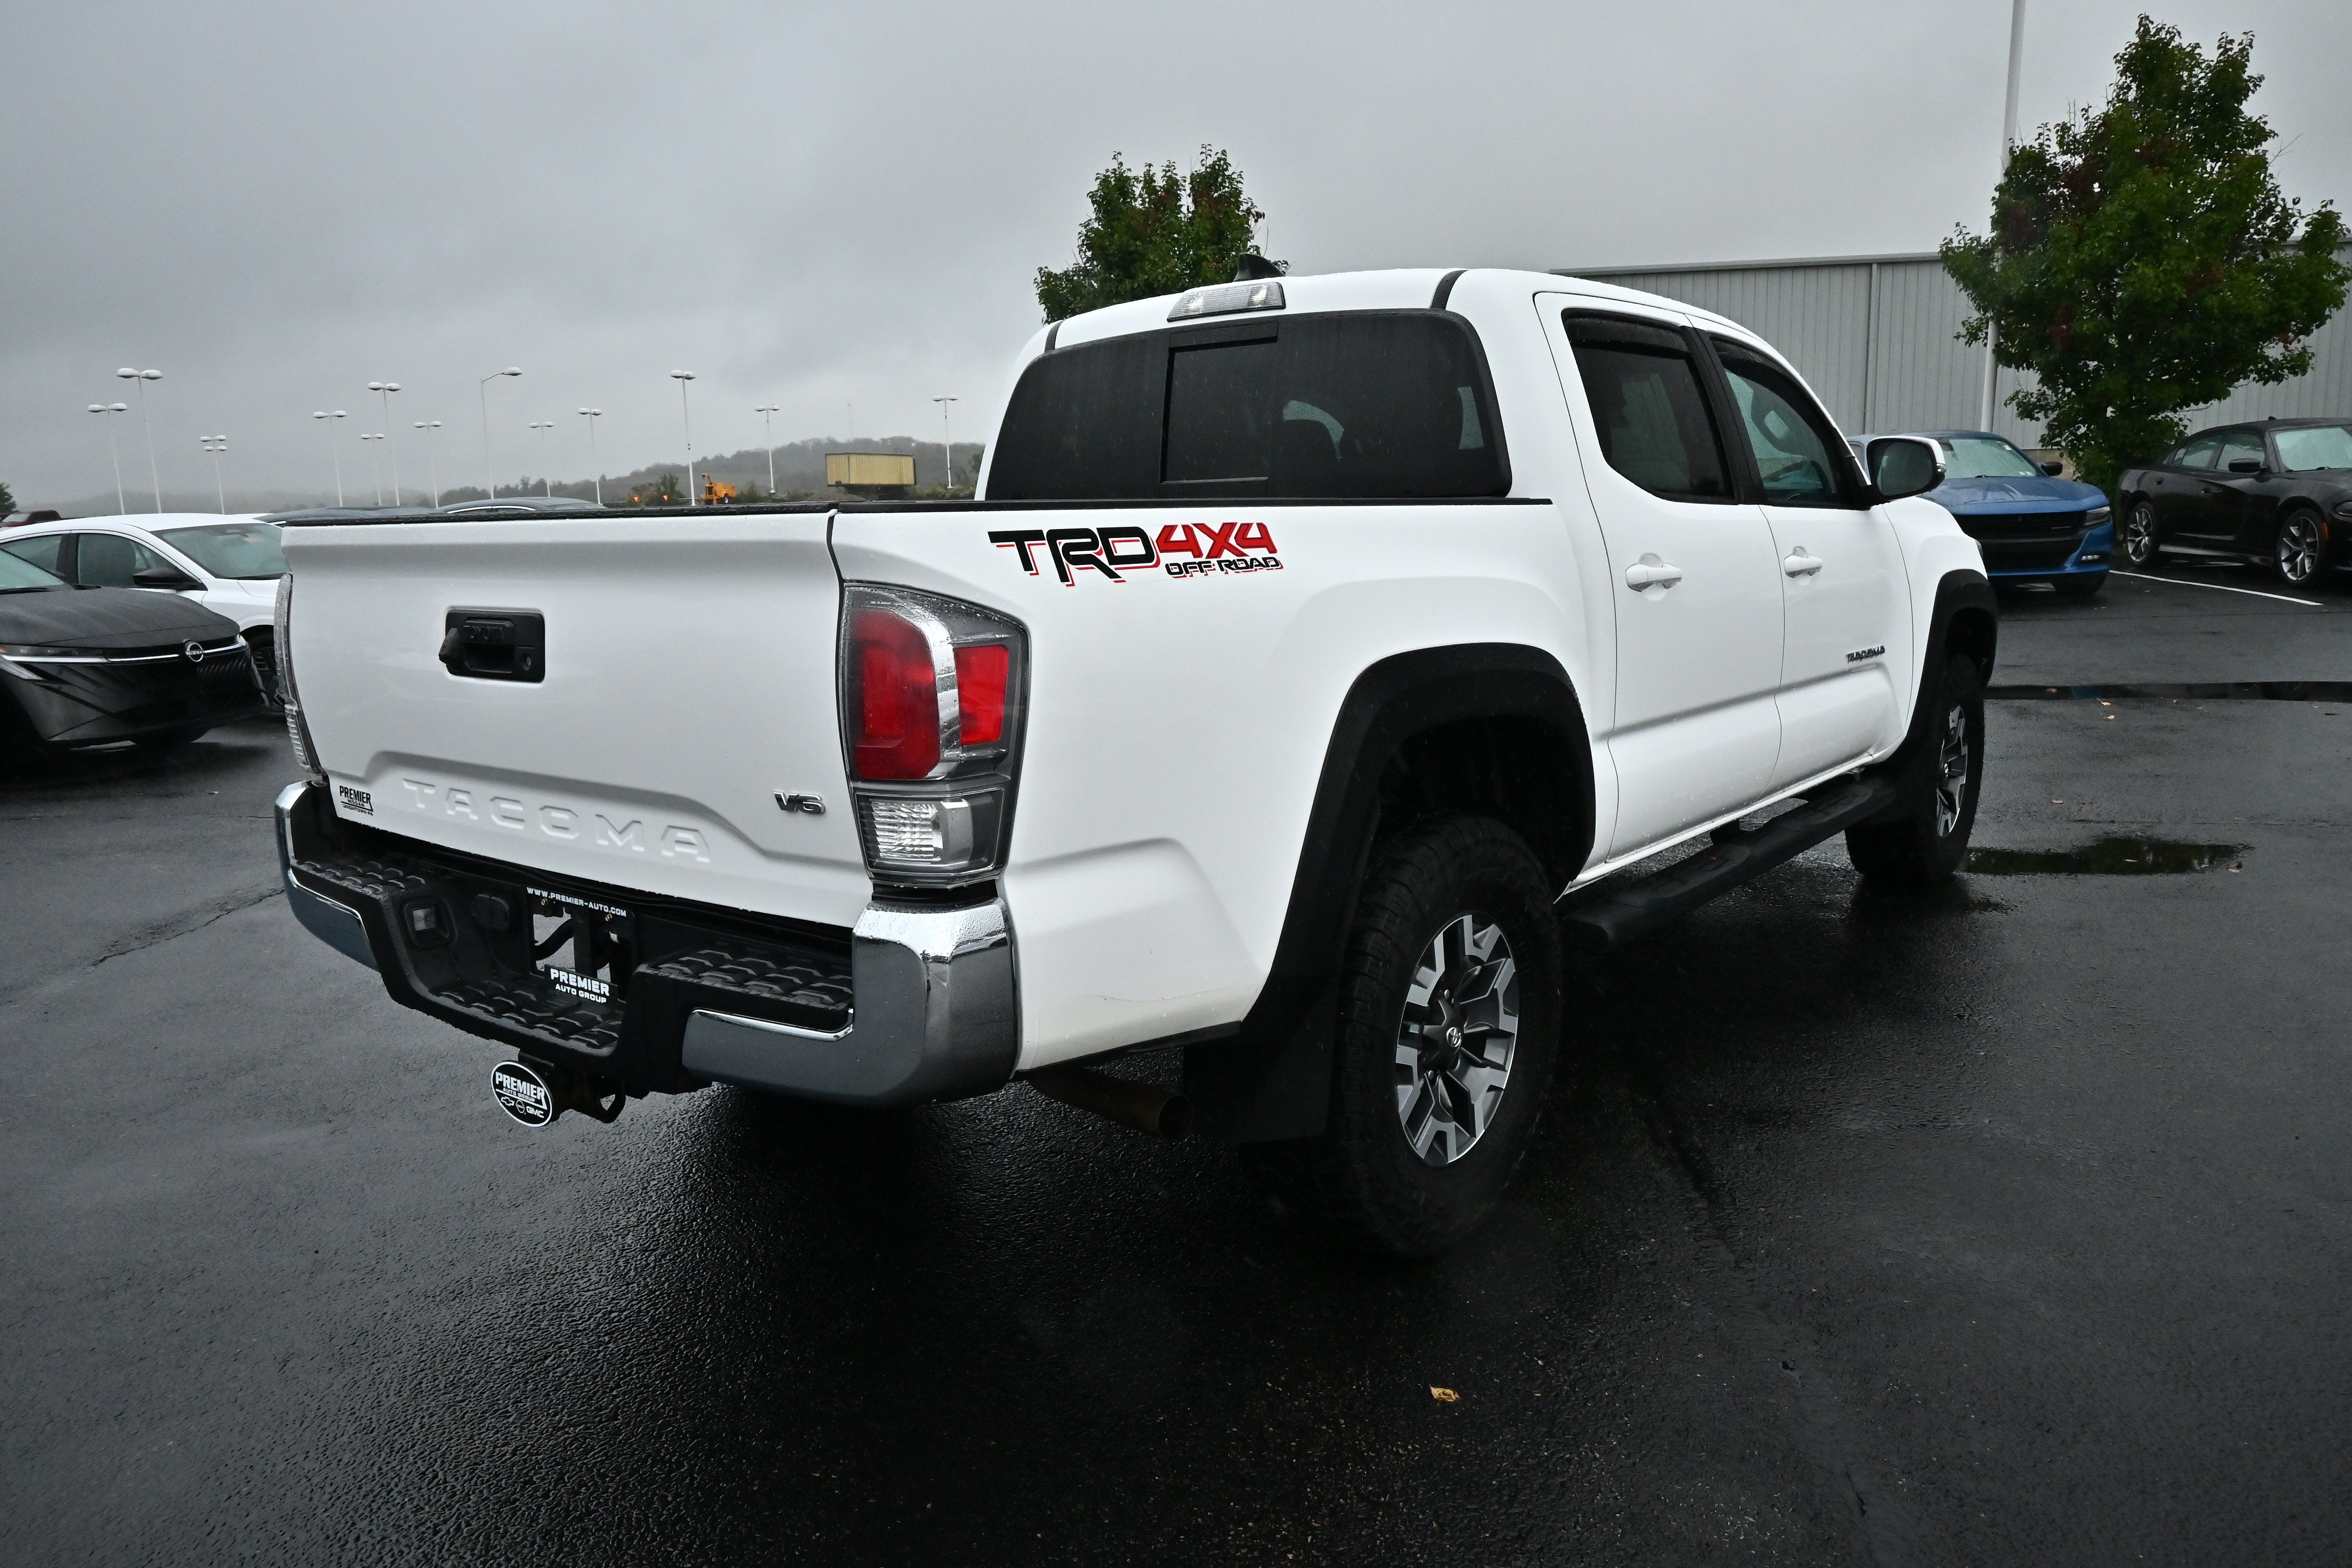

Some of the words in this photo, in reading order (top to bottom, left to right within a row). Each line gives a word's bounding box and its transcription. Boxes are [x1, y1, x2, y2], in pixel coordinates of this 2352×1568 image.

[988, 525, 1160, 587] TRD
[1156, 522, 1277, 559] 4X4
[1165, 560, 1216, 578] OFF
[1217, 556, 1283, 573] ROAD
[339, 785, 371, 804] PREMIER
[348, 799, 365, 807] NISSAN
[773, 791, 826, 814] V6
[402, 778, 710, 863] TACOMA
[527, 887, 626, 917] WWW.PREMIER-AUTO.COM
[550, 968, 610, 996] PREMIER
[555, 983, 577, 995] AUTO
[578, 991, 607, 1004] GROUP
[495, 1072, 545, 1100] PREMIER
[503, 1087, 517, 1096] AUTO
[517, 1092, 535, 1102] GROUP
[526, 1106, 544, 1118] GMC
